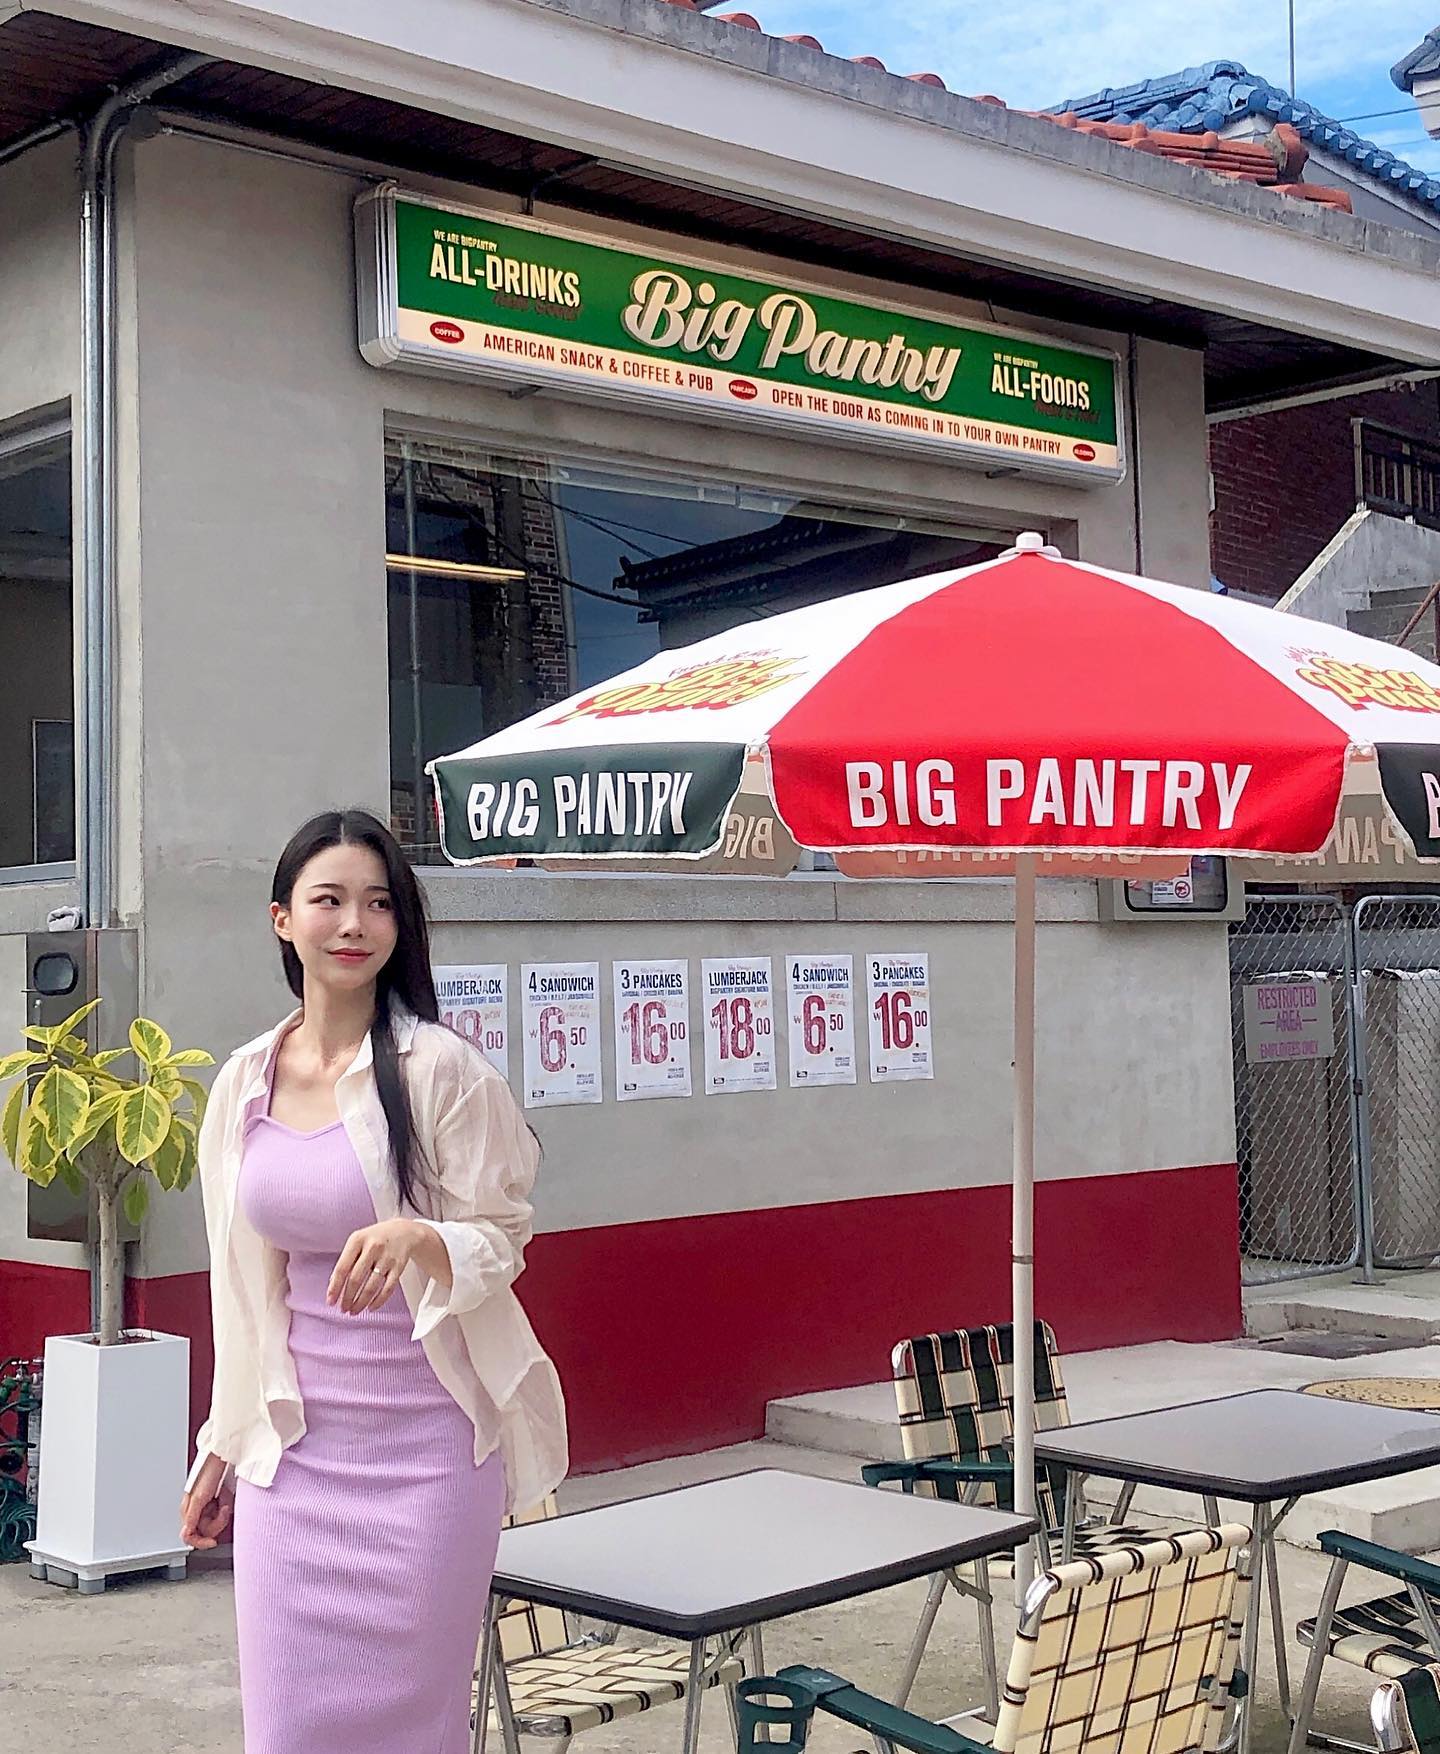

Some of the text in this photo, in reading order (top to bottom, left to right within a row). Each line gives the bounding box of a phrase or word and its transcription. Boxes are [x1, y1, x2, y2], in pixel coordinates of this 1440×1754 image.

[433, 229, 446, 242] WE
[447, 233, 459, 245] ARE
[430, 243, 581, 308] ALL-DRINKS
[434, 327, 461, 339] COFFEE
[621, 270, 962, 402] Big Pantry
[483, 333, 713, 391] AMERICAN SNACK & COFFEE & PUB
[992, 364, 1090, 411] ALL-FOODS
[772, 389, 1061, 455] OPEN THE DOOR AS COMING IN TO YOUR OWN PANTRY
[845, 758, 1253, 830] BIG PANTRY
[467, 772, 693, 841] BIG PANTRY
[529, 971, 594, 993] 4 SANDWICH
[621, 969, 682, 989] 3 PANCAKES
[709, 971, 768, 986] LUMBERJACK
[792, 962, 800, 982] 4
[803, 968, 849, 982] SANDWICH
[872, 961, 880, 980] 3
[883, 966, 925, 980] PANCAKES
[436, 979, 502, 997] LUMBERJACK
[1257, 986, 1317, 1010] RESTRICTED
[1275, 1009, 1302, 1032] AREA
